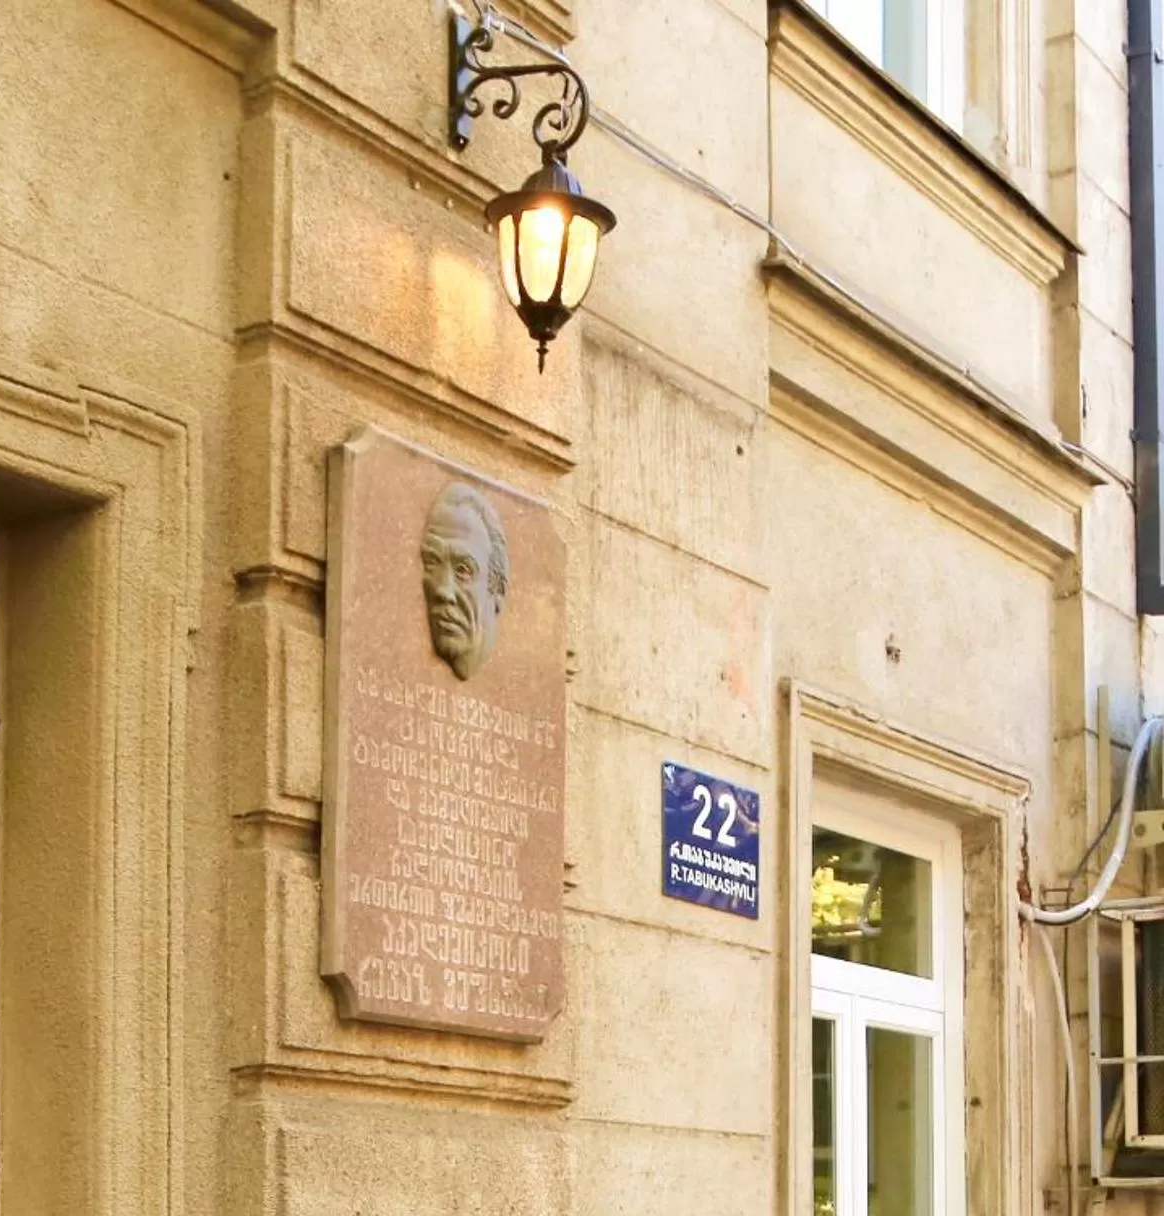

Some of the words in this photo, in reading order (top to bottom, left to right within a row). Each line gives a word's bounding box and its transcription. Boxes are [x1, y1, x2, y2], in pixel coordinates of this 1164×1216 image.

[397, 813, 517, 870] სამედიცინო
[692, 784, 737, 847] 22
[390, 844, 523, 903] რადიოლოგიის
[382, 911, 530, 976] აკადემიკოსი
[357, 954, 432, 1006] რევაზ
